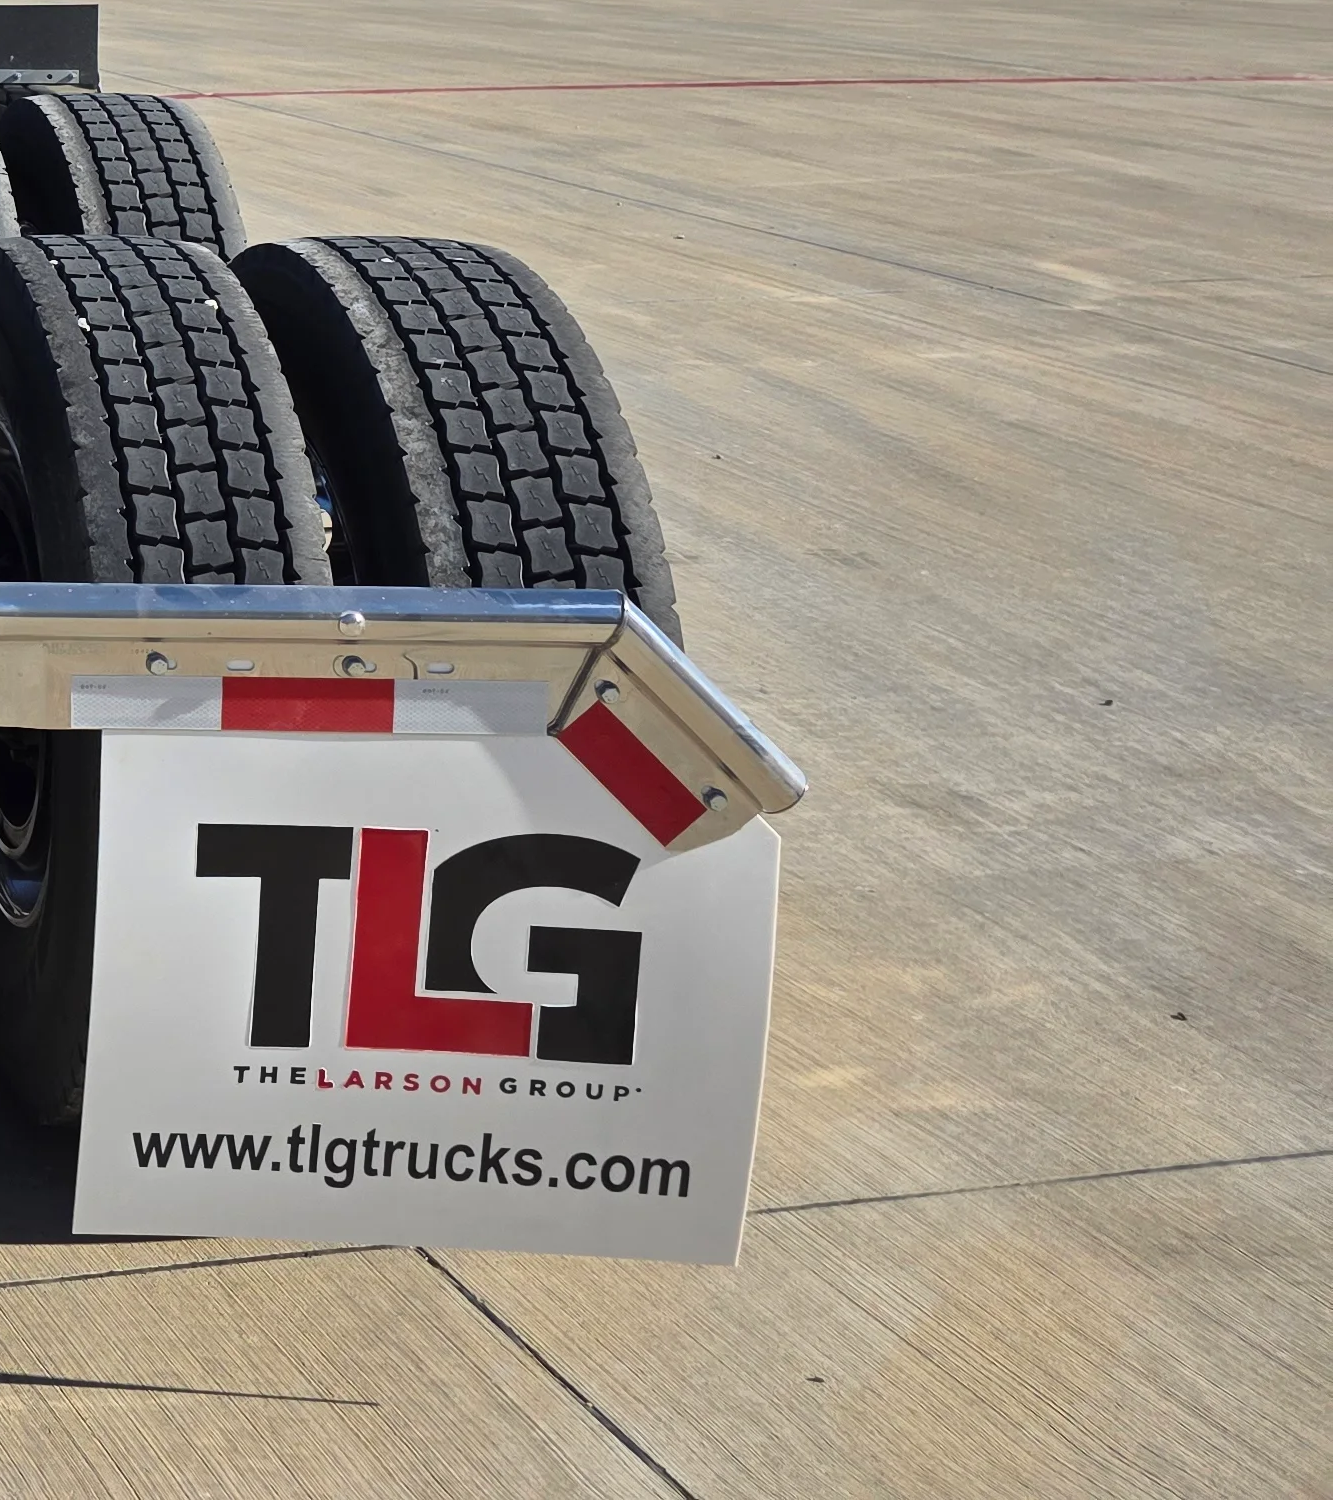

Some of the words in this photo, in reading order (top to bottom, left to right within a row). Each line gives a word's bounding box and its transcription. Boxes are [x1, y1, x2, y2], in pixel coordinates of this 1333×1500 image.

[194, 823, 642, 1065] TLG
[233, 1065, 307, 1084] THE
[316, 1067, 482, 1095] LARSON
[499, 1077, 631, 1102] GROUP
[132, 1123, 691, 1198] www.tlgtrucks.com
